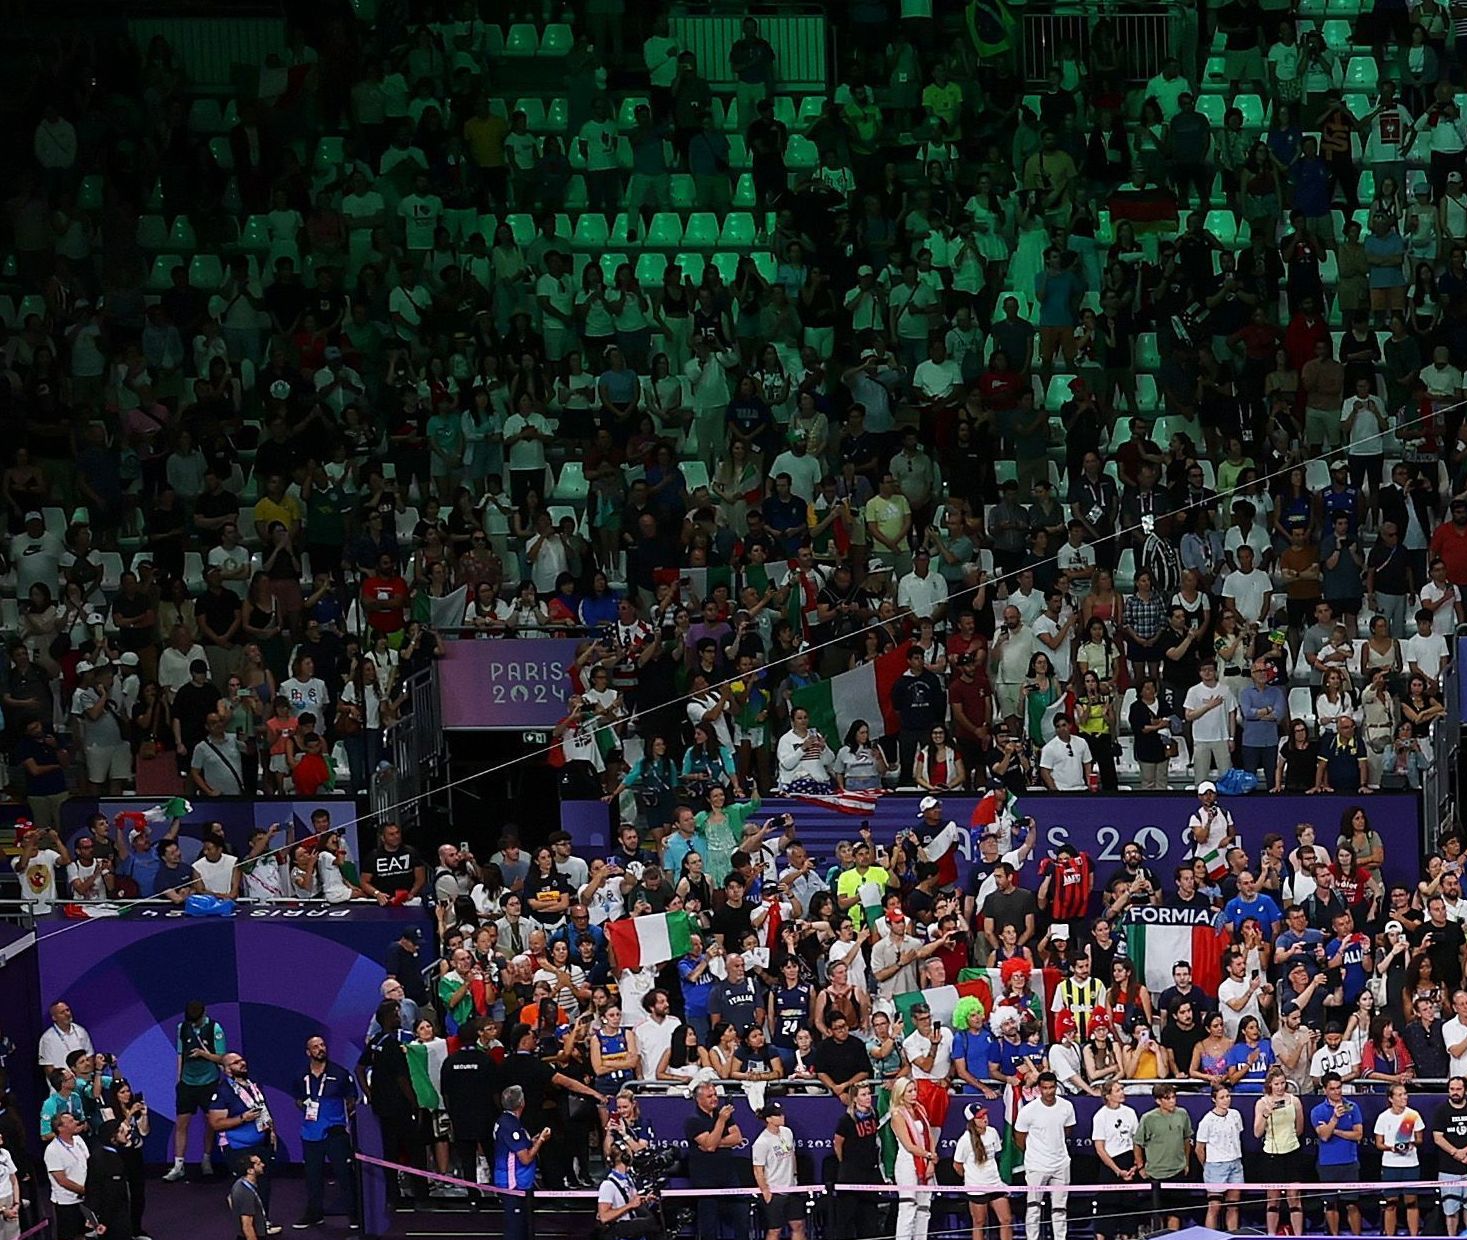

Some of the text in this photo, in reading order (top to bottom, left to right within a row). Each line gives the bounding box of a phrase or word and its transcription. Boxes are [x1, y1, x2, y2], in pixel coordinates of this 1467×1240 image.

[490, 661, 563, 681] PARIS
[492, 683, 567, 704] 2024
[377, 853, 411, 873] EA7
[1131, 905, 1214, 925] FORMIA
[728, 992, 755, 1006] ITALIA
[1237, 1062, 1266, 1073] IALIA
[1321, 1055, 1351, 1077] GUCCI
[856, 1118, 879, 1138] USA
[807, 1140, 833, 1148] 202
